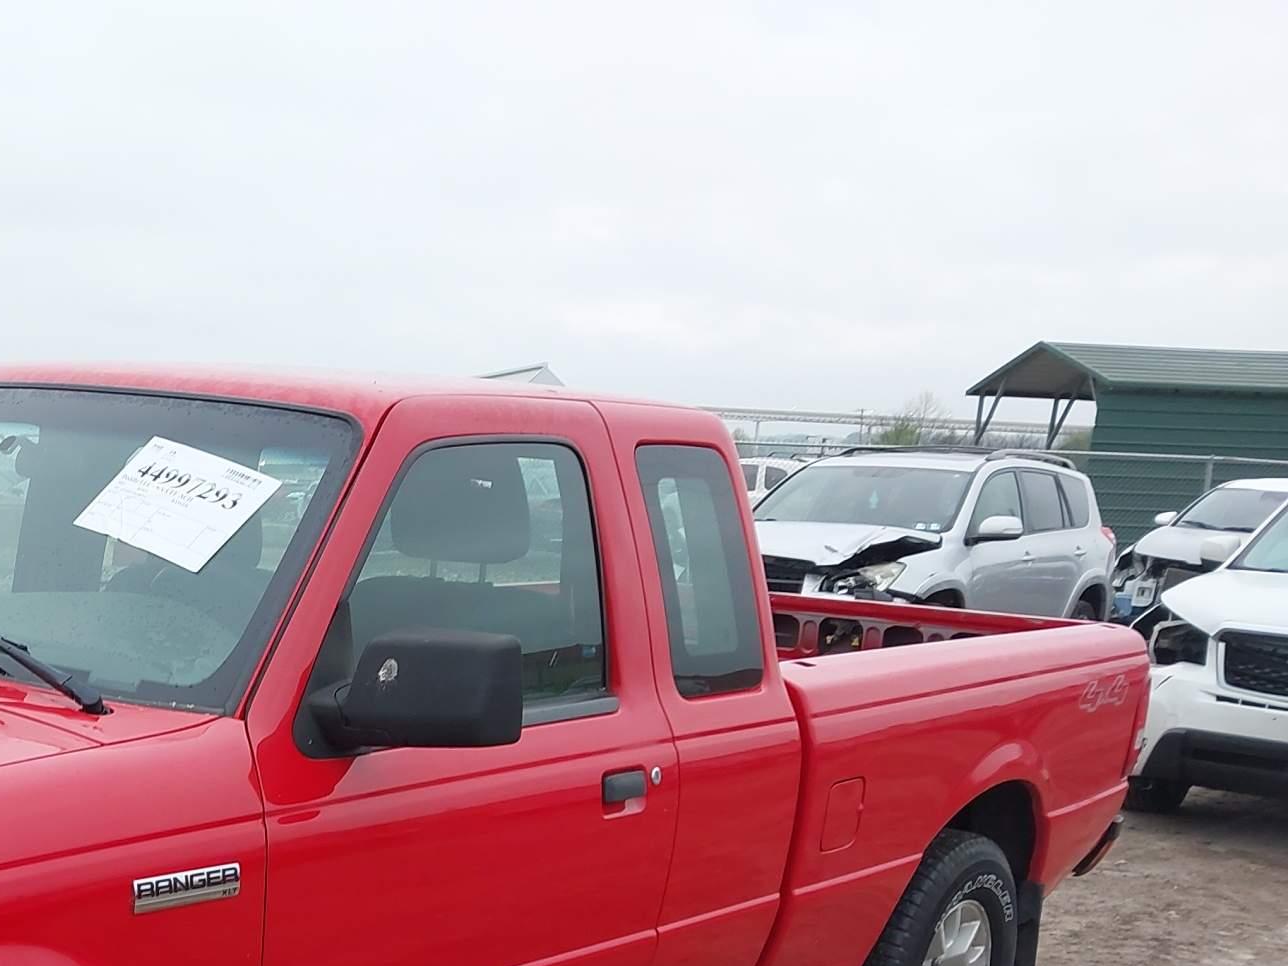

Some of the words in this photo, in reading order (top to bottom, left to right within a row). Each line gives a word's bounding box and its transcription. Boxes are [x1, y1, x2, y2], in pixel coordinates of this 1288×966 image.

[137, 462, 244, 510] 44997293
[135, 866, 241, 900] RANGER
[221, 887, 239, 897] XLT
